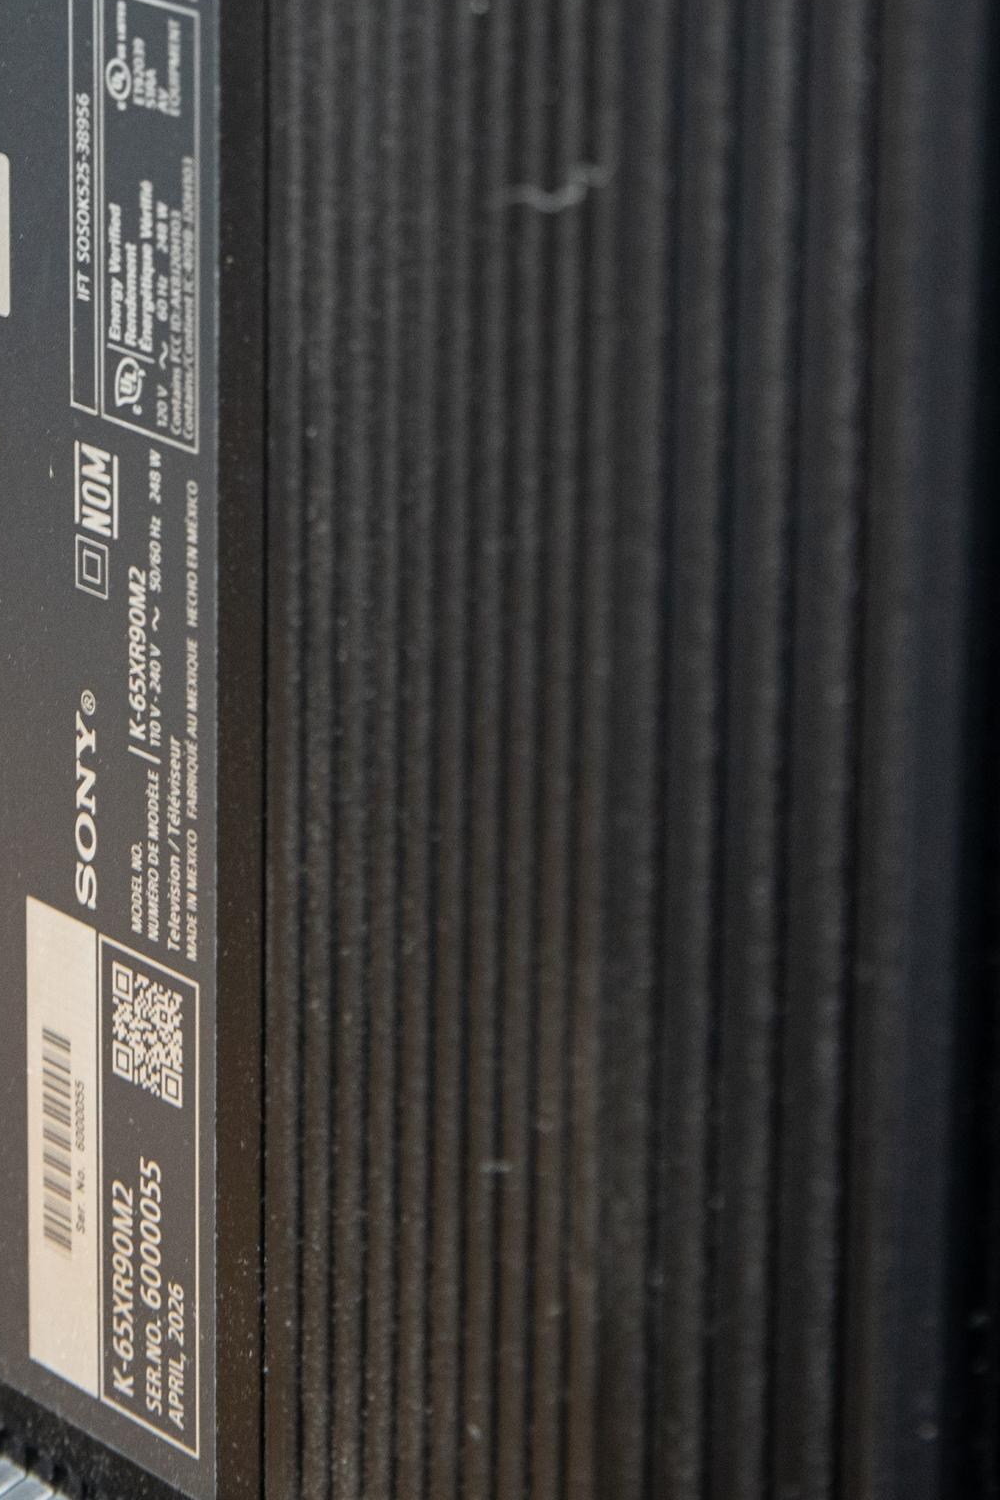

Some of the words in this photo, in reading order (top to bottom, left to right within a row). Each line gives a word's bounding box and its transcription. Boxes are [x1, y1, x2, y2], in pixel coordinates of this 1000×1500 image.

[157, 201, 168, 219] W
[108, 202, 121, 273] Verified
[76, 270, 91, 302] IFT
[108, 278, 123, 342] Energy
[125, 242, 137, 347] Rendement
[157, 275, 168, 297] Hz
[157, 298, 168, 322] 60
[157, 385, 168, 398] V
[157, 401, 168, 427] 120
[170, 367, 181, 435] Contains
[149, 449, 161, 468] W
[81, 442, 112, 537] NOM
[149, 471, 161, 503] 248
[185, 480, 199, 544] MÉXICO
[149, 516, 161, 539] Hz
[149, 540, 161, 593] 50/60
[186, 546, 199, 569] EN
[186, 571, 199, 628] HECHO
[128, 565, 147, 741] K-65XR90M2
[149, 643, 161, 656] V
[186, 637, 199, 712] MEXIQUE
[149, 660, 161, 694] 240
[150, 704, 161, 717] V
[150, 720, 161, 747] 110
[187, 714, 198, 739] AU
[145, 769, 160, 840] MODÈLE
[167, 735, 181, 836] Téléviseur
[184, 740, 199, 820] FABRIQUÉ
[131, 841, 143, 871] NO.
[148, 842, 160, 866] DE
[168, 838, 181, 852] /
[187, 829, 198, 891] MEXICO
[131, 872, 143, 934] MODEL
[146, 868, 160, 942] NUMÉRO
[167, 855, 181, 951] Television
[187, 893, 198, 912] IN
[187, 914, 198, 962] MADE
[76, 1166, 85, 1194] No.
[140, 1156, 161, 1310] 6000055
[112, 1179, 134, 1397] K-65XR90M2
[168, 1281, 184, 1346] 2026
[146, 1319, 162, 1416] SER.NO.
[168, 1352, 186, 1430] APRIL,
